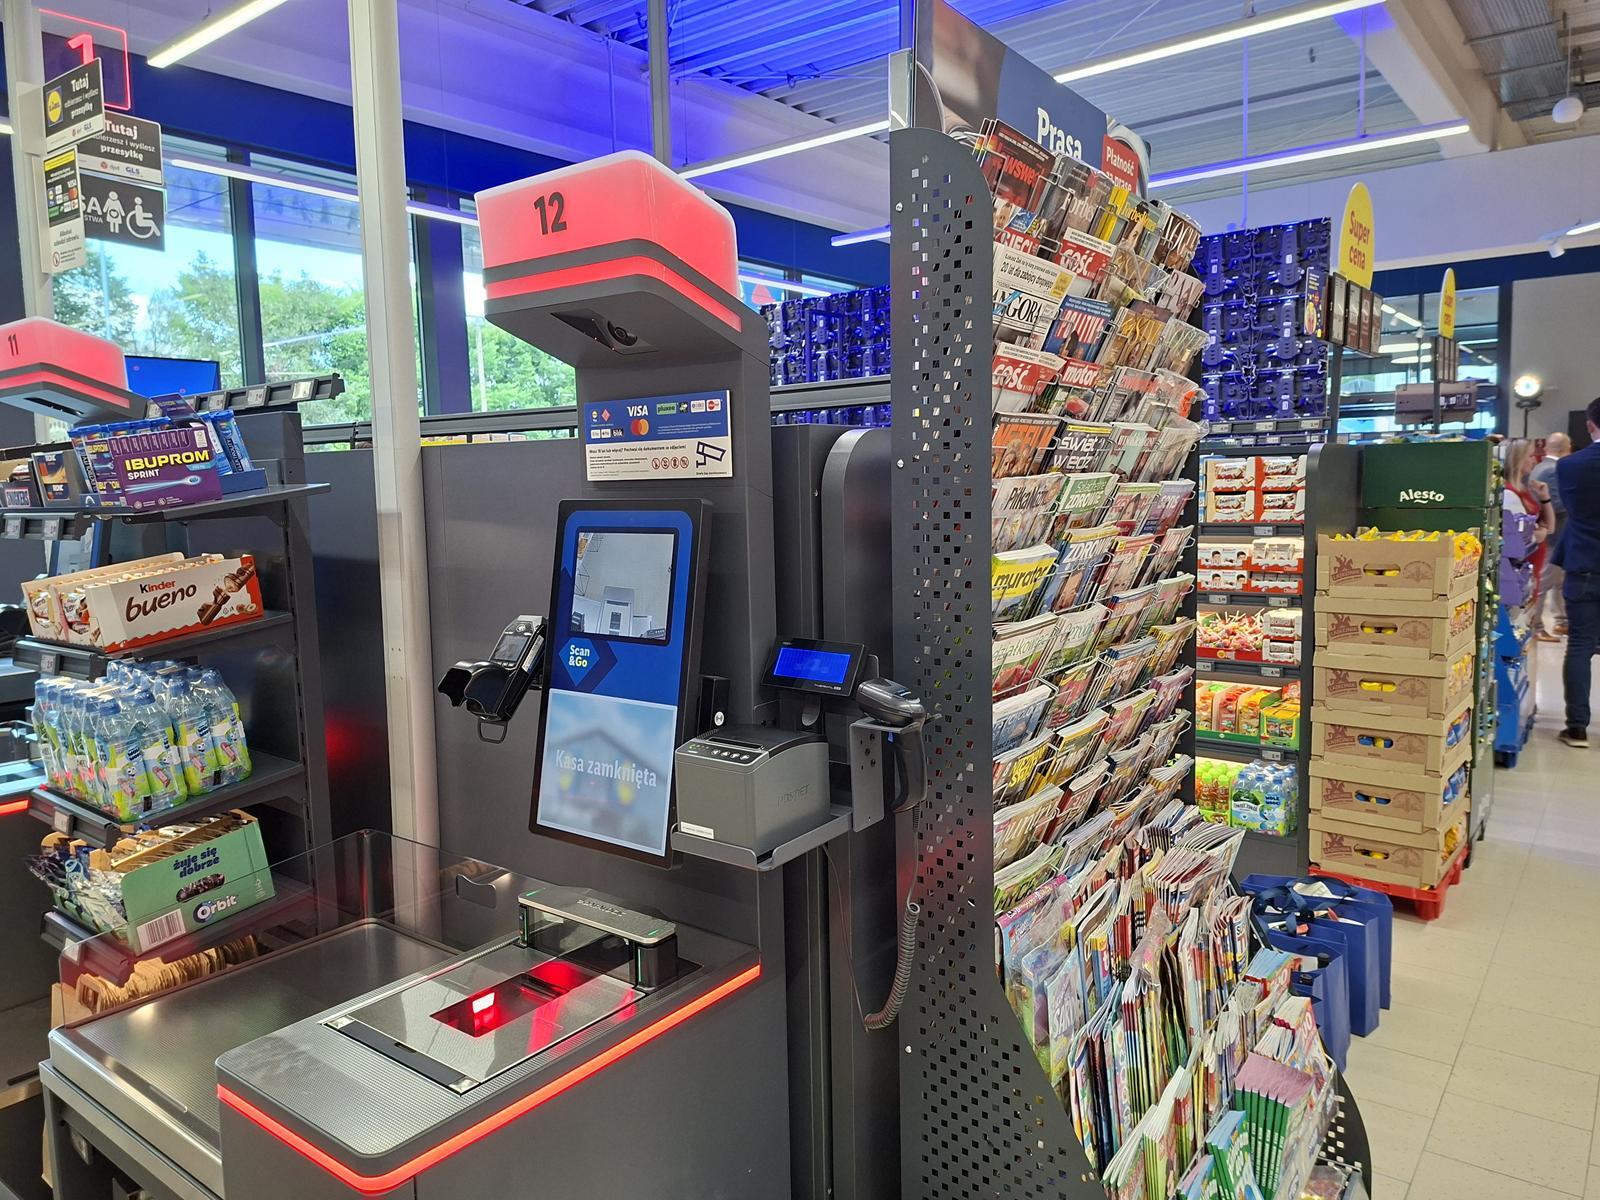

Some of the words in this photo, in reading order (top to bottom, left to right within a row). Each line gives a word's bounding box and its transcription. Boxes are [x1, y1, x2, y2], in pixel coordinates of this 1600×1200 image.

[70, 73, 89, 93] Tutaj
[104, 119, 138, 140] Tutaj
[1037, 107, 1082, 161] Prasa
[100, 143, 144, 162] przesyłkę
[1106, 146, 1135, 176] Płatność
[533, 191, 568, 236] 12
[1349, 210, 1371, 245] Super
[1349, 245, 1366, 271] cena
[7, 333, 18, 357] 11
[626, 404, 649, 417] VISA
[125, 448, 211, 472] IBUPROM
[127, 468, 161, 480] SPRINT
[1399, 488, 1445, 504] Alesto
[993, 565, 1049, 589] murator
[125, 584, 197, 623] bueno
[568, 656, 588, 668] &Go
[569, 644, 590, 657] Scan
[555, 750, 584, 773] Kasa
[587, 759, 657, 789] zamknięta
[172, 854, 200, 872] żuje
[200, 847, 218, 862] się
[179, 856, 220, 879] dobrze
[195, 895, 237, 921] Orbit
